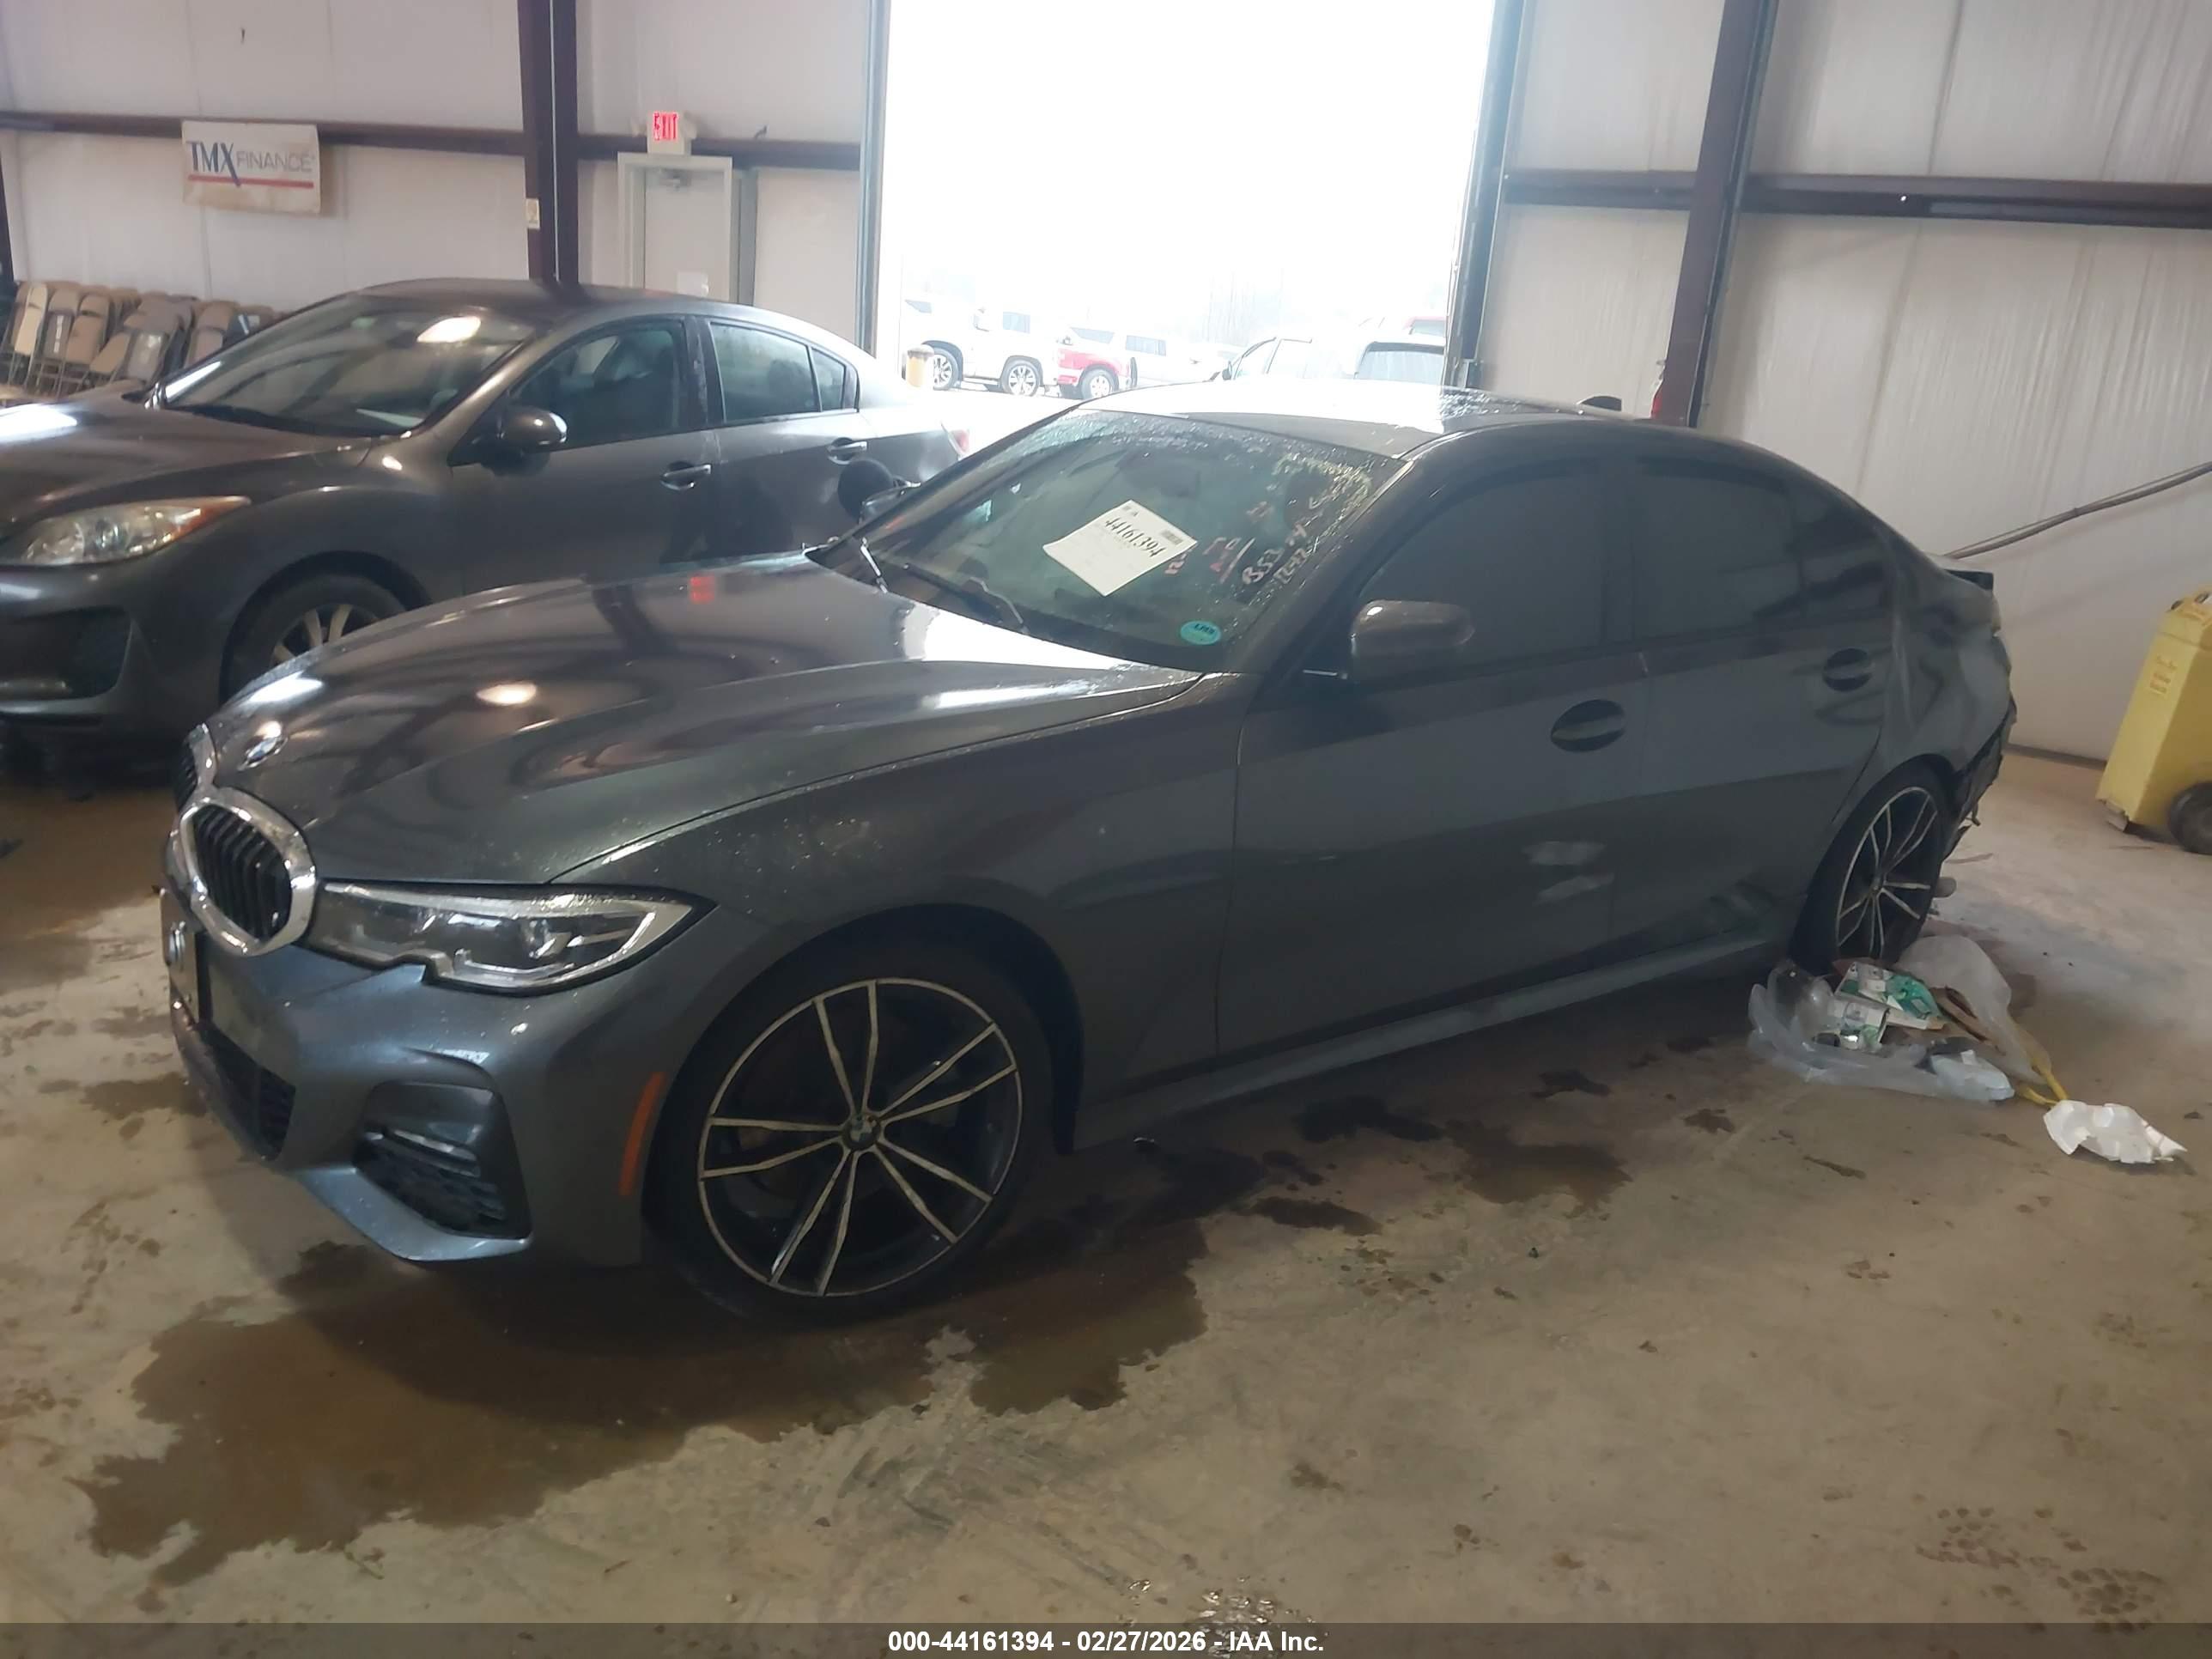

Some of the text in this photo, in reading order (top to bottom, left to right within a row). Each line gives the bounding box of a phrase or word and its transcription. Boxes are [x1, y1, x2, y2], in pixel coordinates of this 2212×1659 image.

[653, 112, 678, 141] EXIT
[185, 140, 241, 187] TMX
[1105, 517, 1166, 557] 44161394
